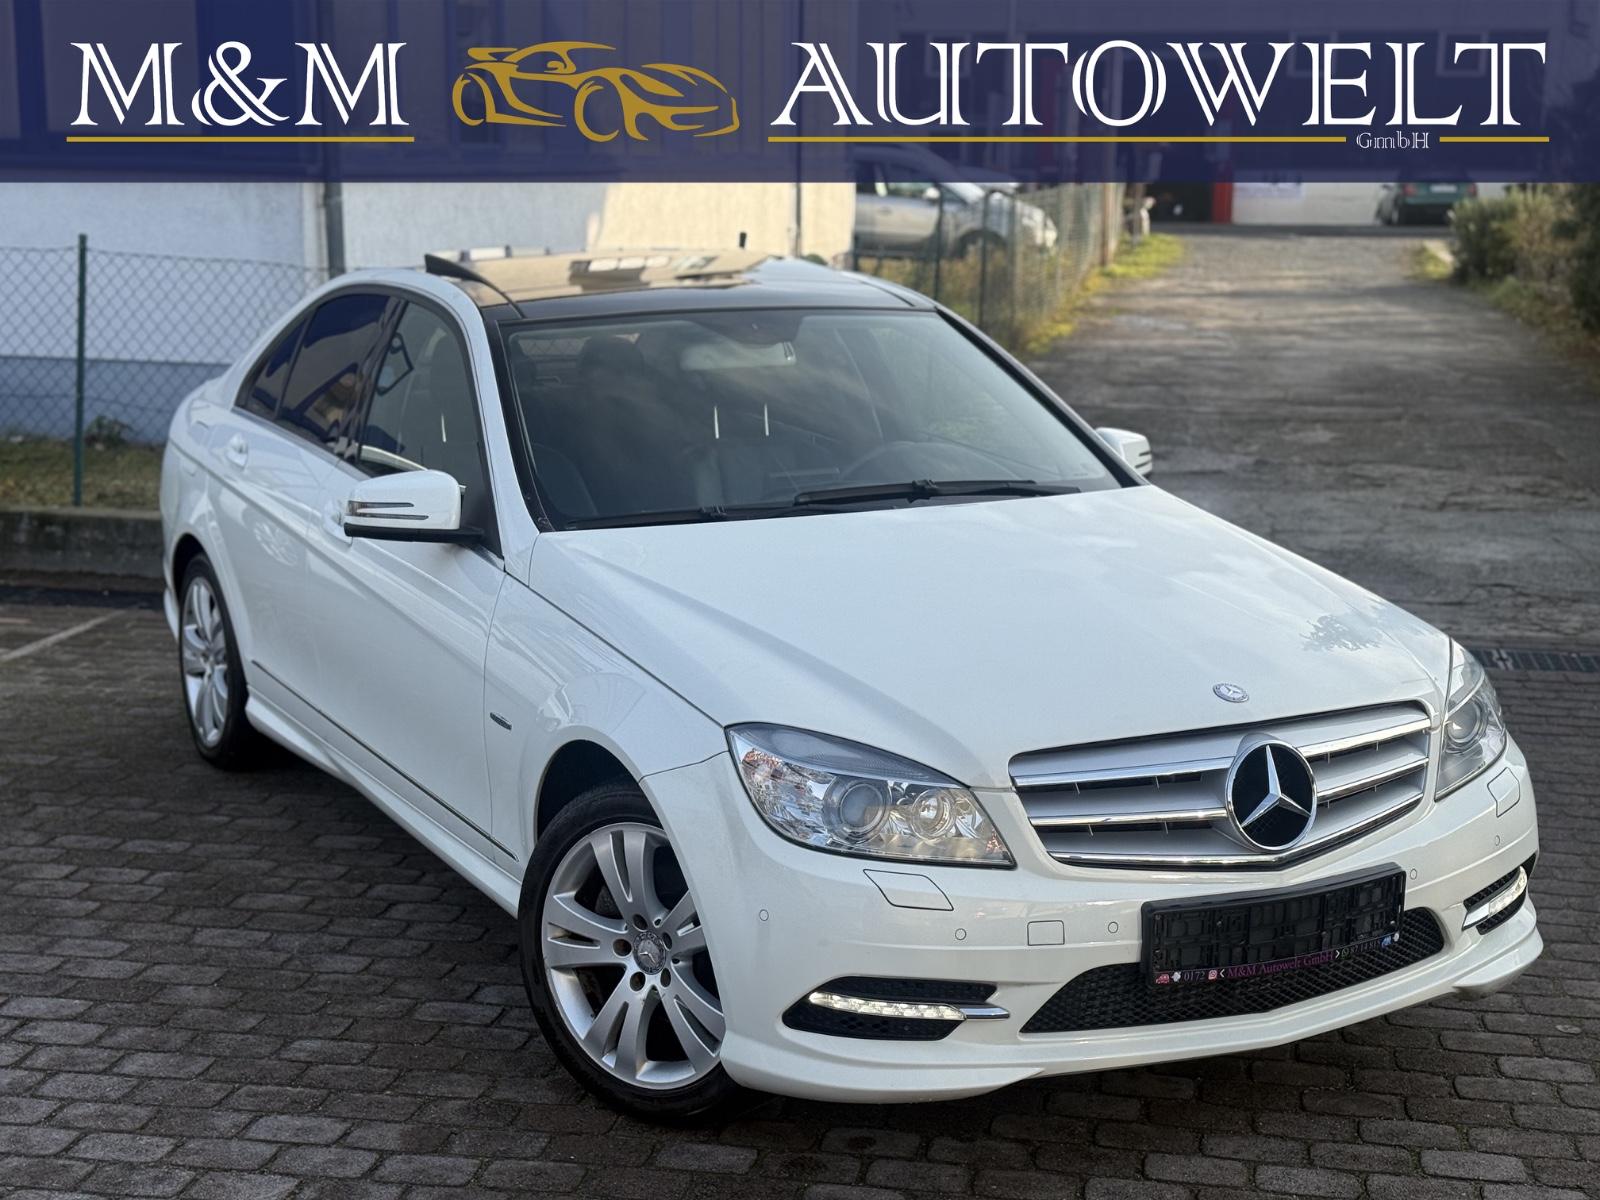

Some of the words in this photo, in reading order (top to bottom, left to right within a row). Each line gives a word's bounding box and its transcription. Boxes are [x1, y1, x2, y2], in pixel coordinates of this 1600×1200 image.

[1227, 965, 1257, 978] M&M
[1259, 956, 1301, 975] Autowelt
[1303, 950, 1335, 967] GmbH
